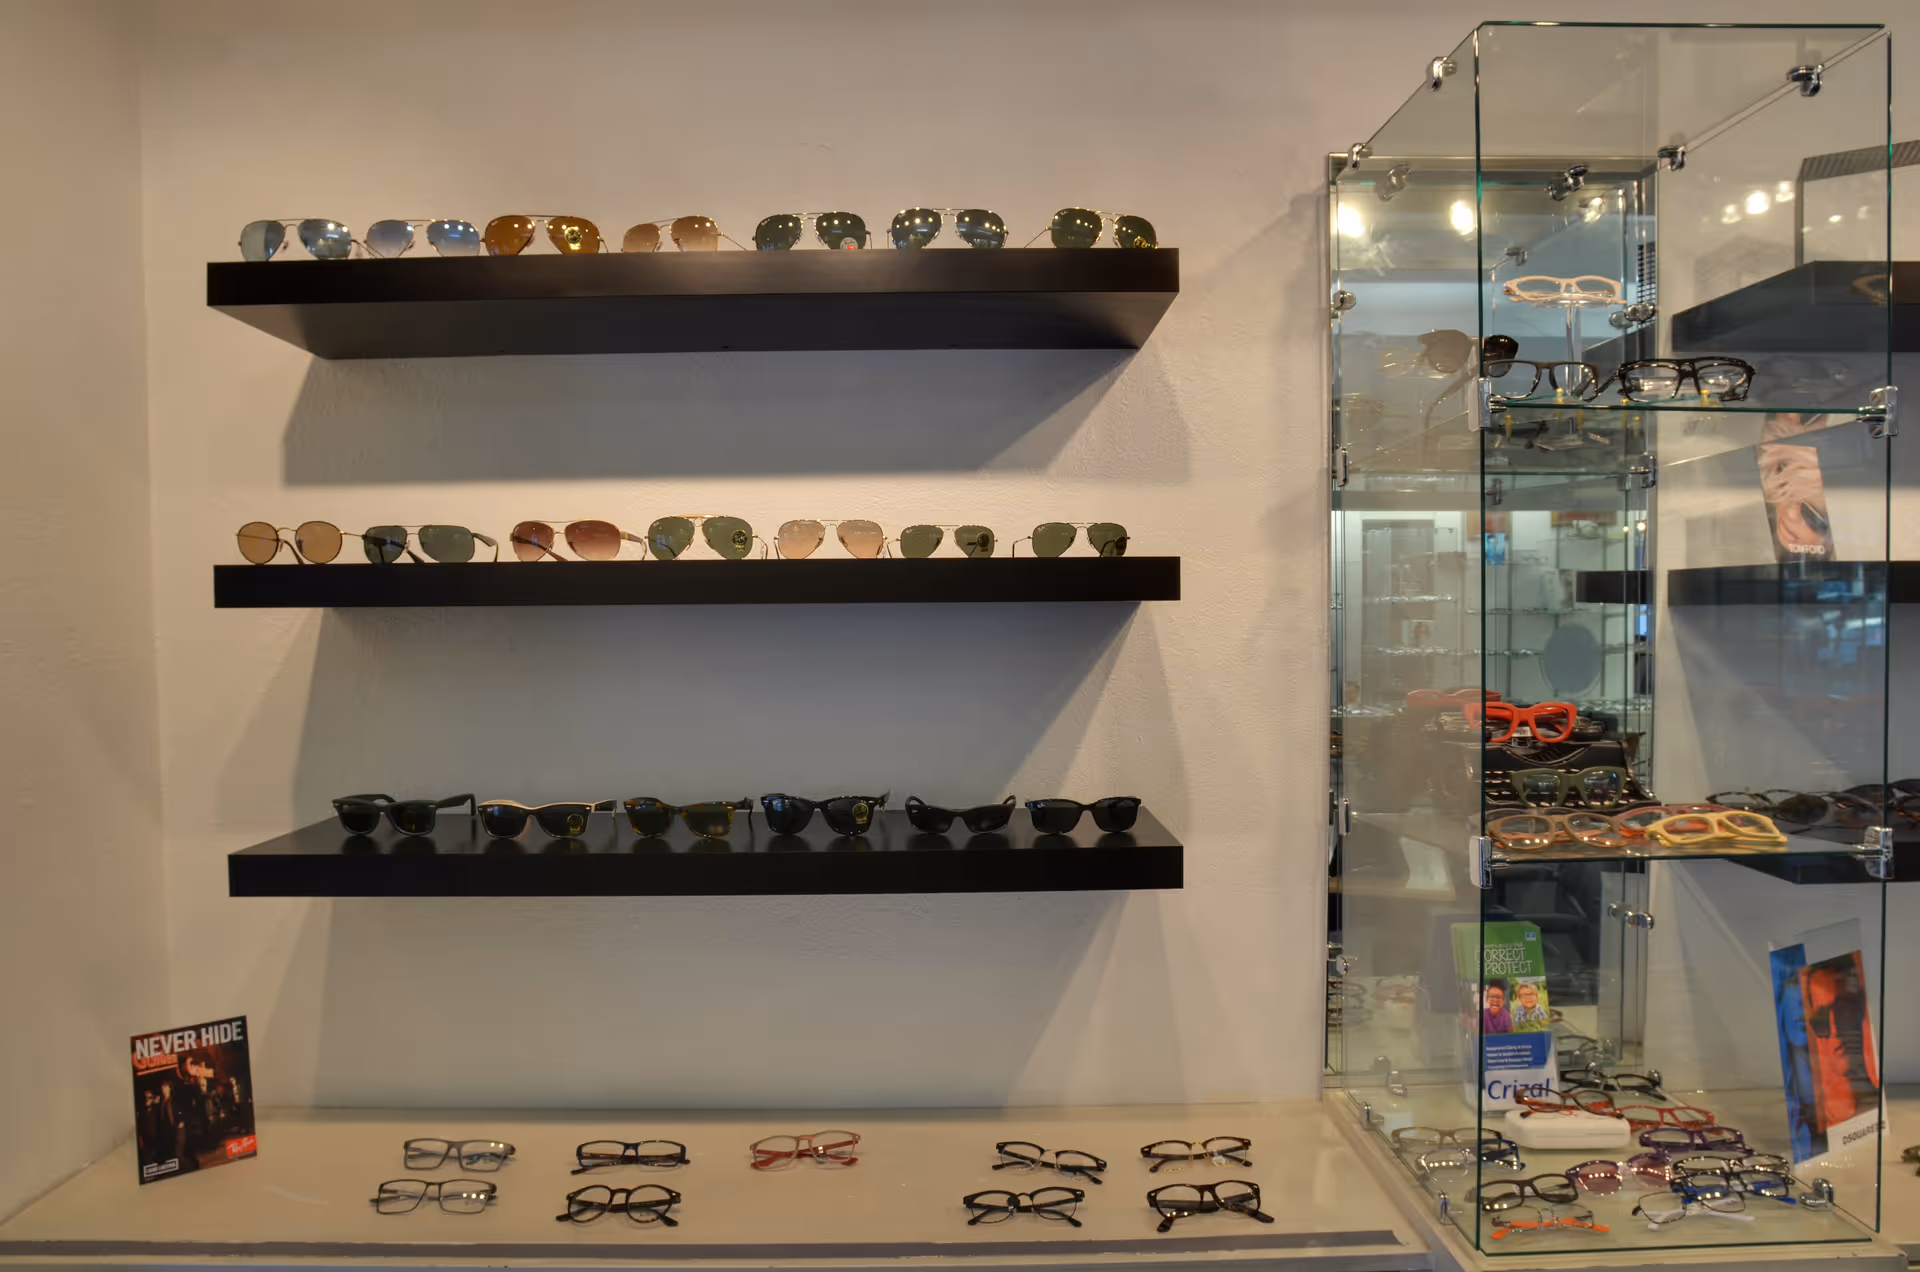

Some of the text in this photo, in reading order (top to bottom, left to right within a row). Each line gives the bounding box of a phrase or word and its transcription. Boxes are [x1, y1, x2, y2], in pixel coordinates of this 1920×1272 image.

[1484, 960, 1533, 975] PROTECT
[135, 1021, 244, 1059] NEVER HIDE
